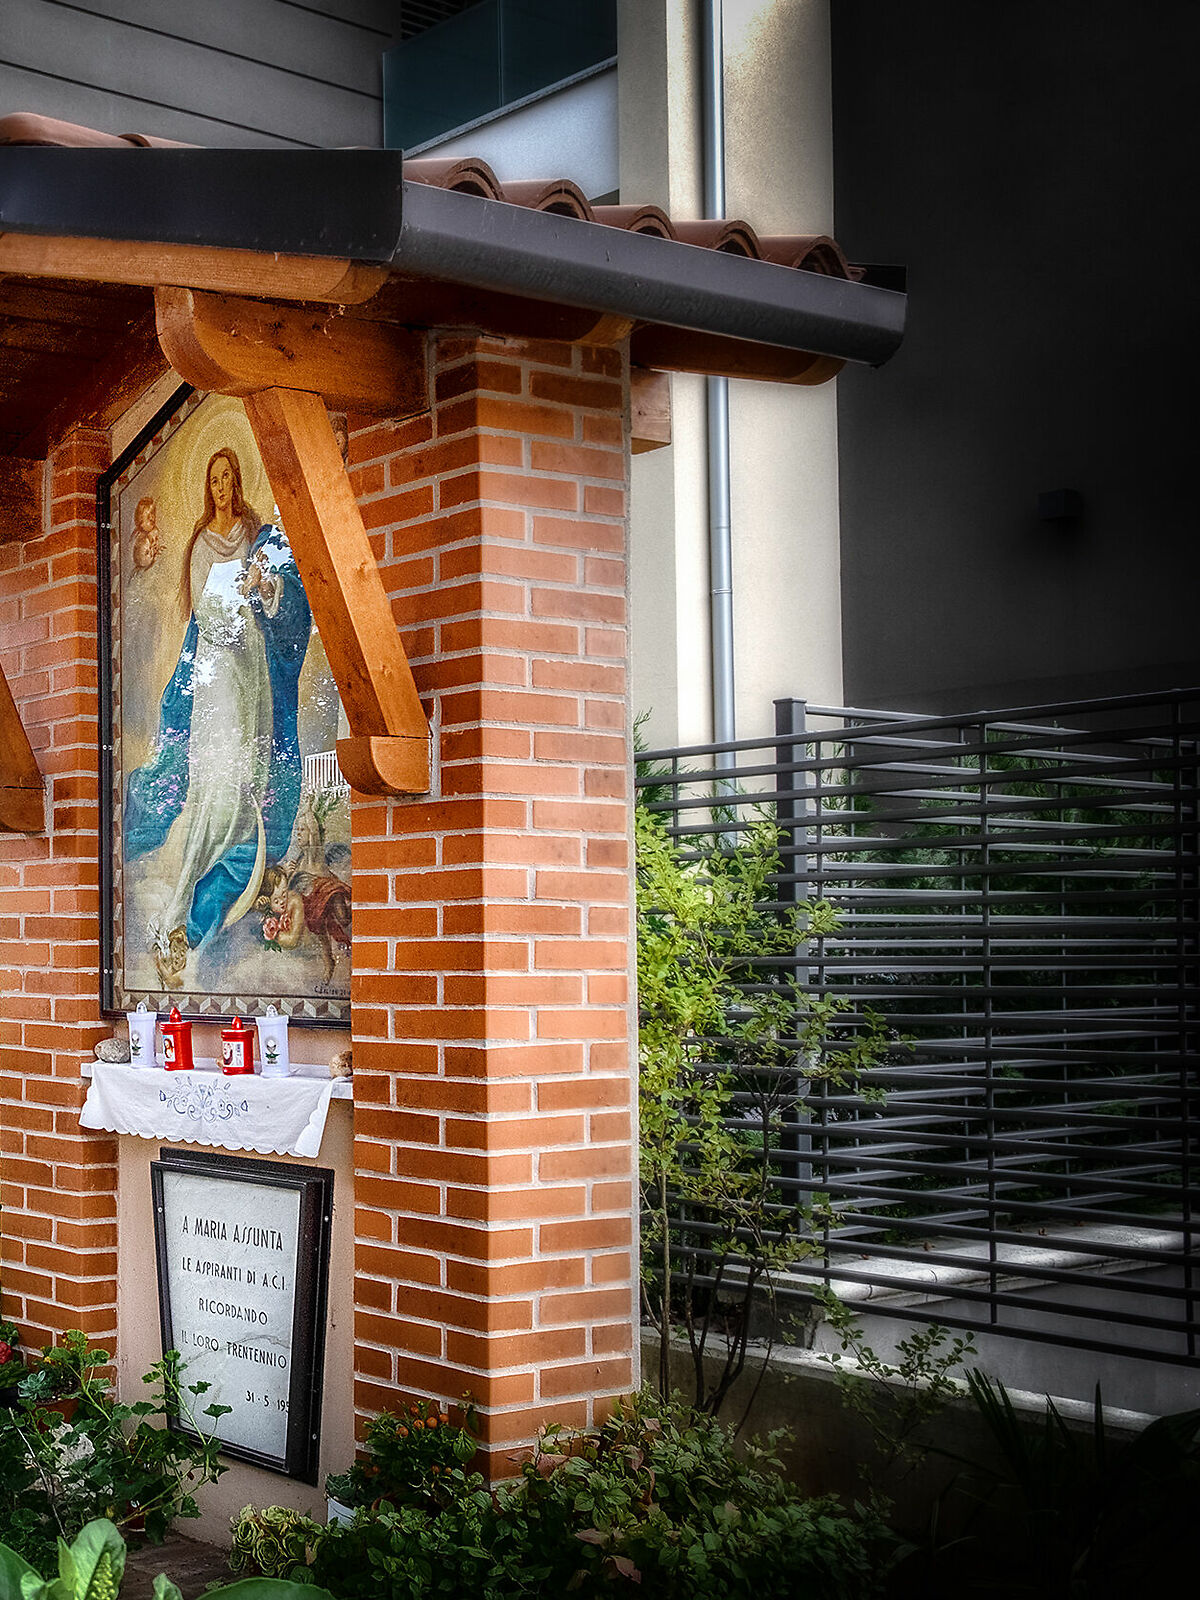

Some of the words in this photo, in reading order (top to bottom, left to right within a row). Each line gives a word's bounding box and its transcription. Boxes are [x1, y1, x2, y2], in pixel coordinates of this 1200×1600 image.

[182, 1216, 189, 1234] A
[194, 1218, 227, 1241] MARIA
[233, 1224, 283, 1251] ASSUNTA
[182, 1257, 191, 1272] LE
[195, 1260, 242, 1282] ASPIRANTI
[247, 1271, 256, 1285] DI
[198, 1298, 268, 1325] RICORDANDO
[181, 1330, 189, 1344] IL
[193, 1333, 219, 1352] LORO
[226, 1341, 287, 1369] TRENTENNIO
